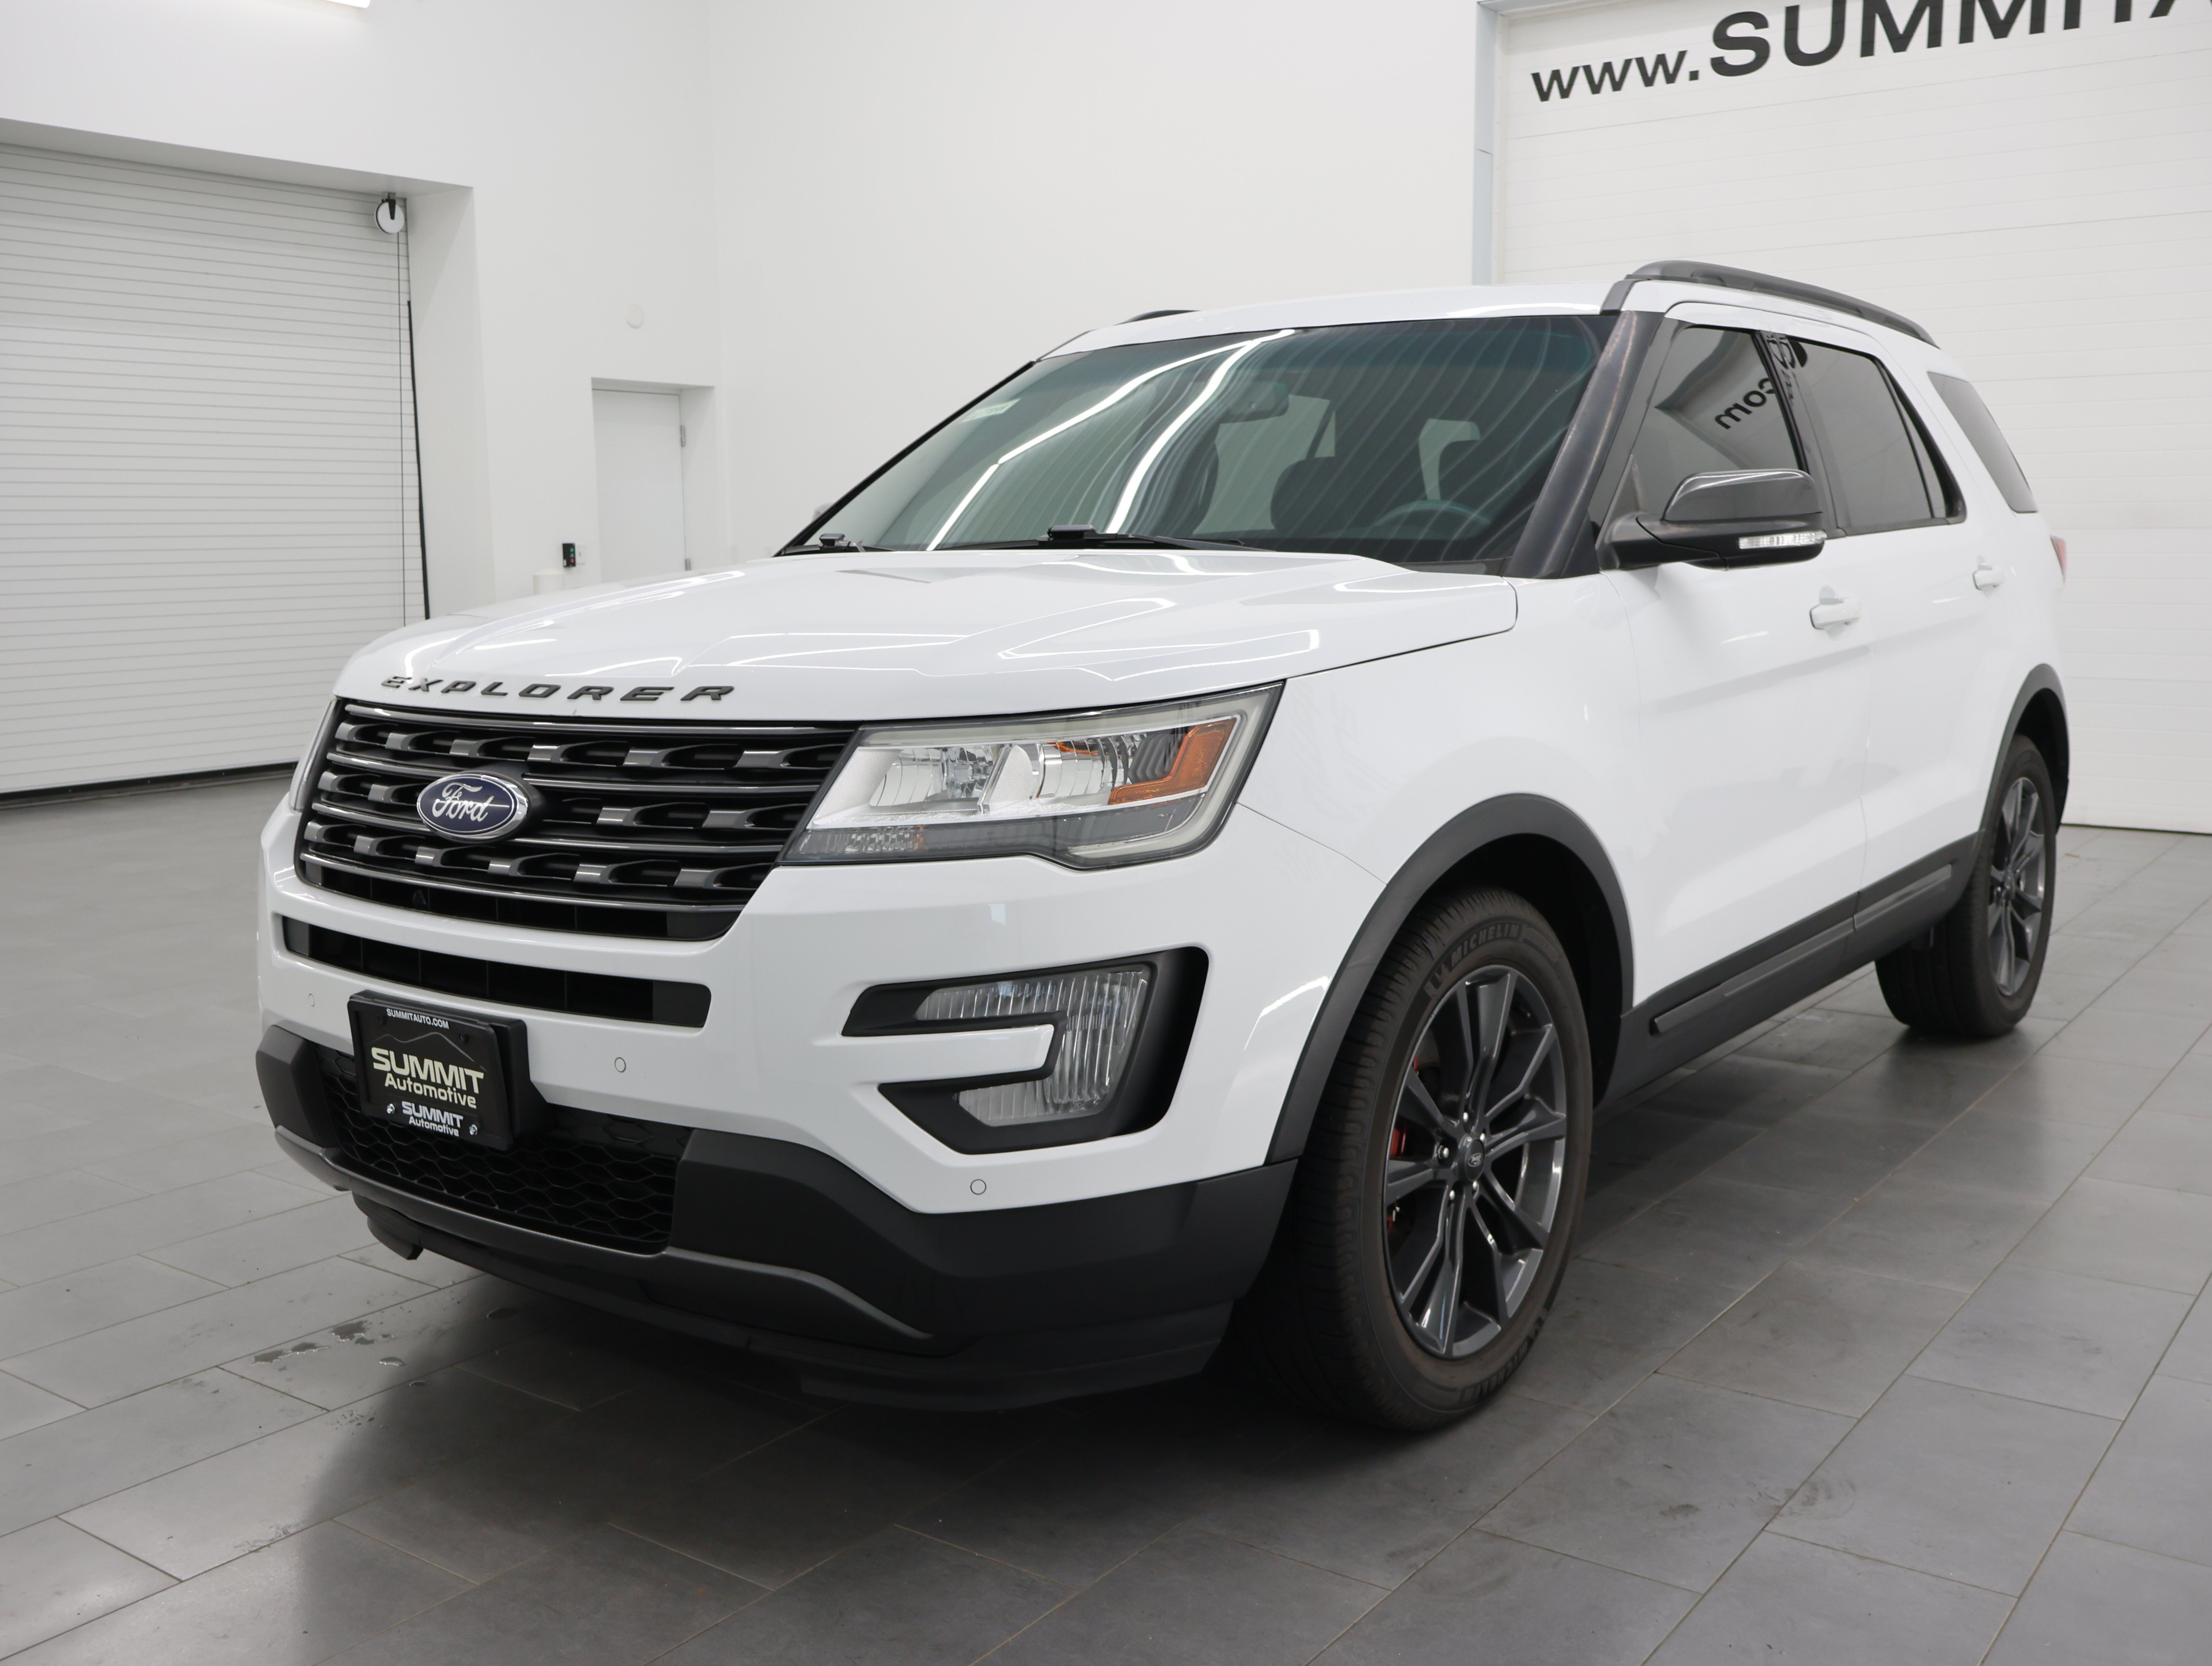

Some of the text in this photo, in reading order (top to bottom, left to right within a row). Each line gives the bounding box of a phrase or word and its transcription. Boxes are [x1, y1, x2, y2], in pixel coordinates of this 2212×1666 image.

[381, 675, 734, 701] EXPLORER
[432, 782, 494, 822] Ford
[1451, 924, 1520, 967] MICHELIN
[386, 1008, 449, 1029] SUMMITAUTO.COM
[371, 1047, 484, 1094] SUMMIT
[385, 1073, 477, 1109] Automotive
[402, 1101, 464, 1128] SUMMIT
[409, 1116, 459, 1137] Automotive
